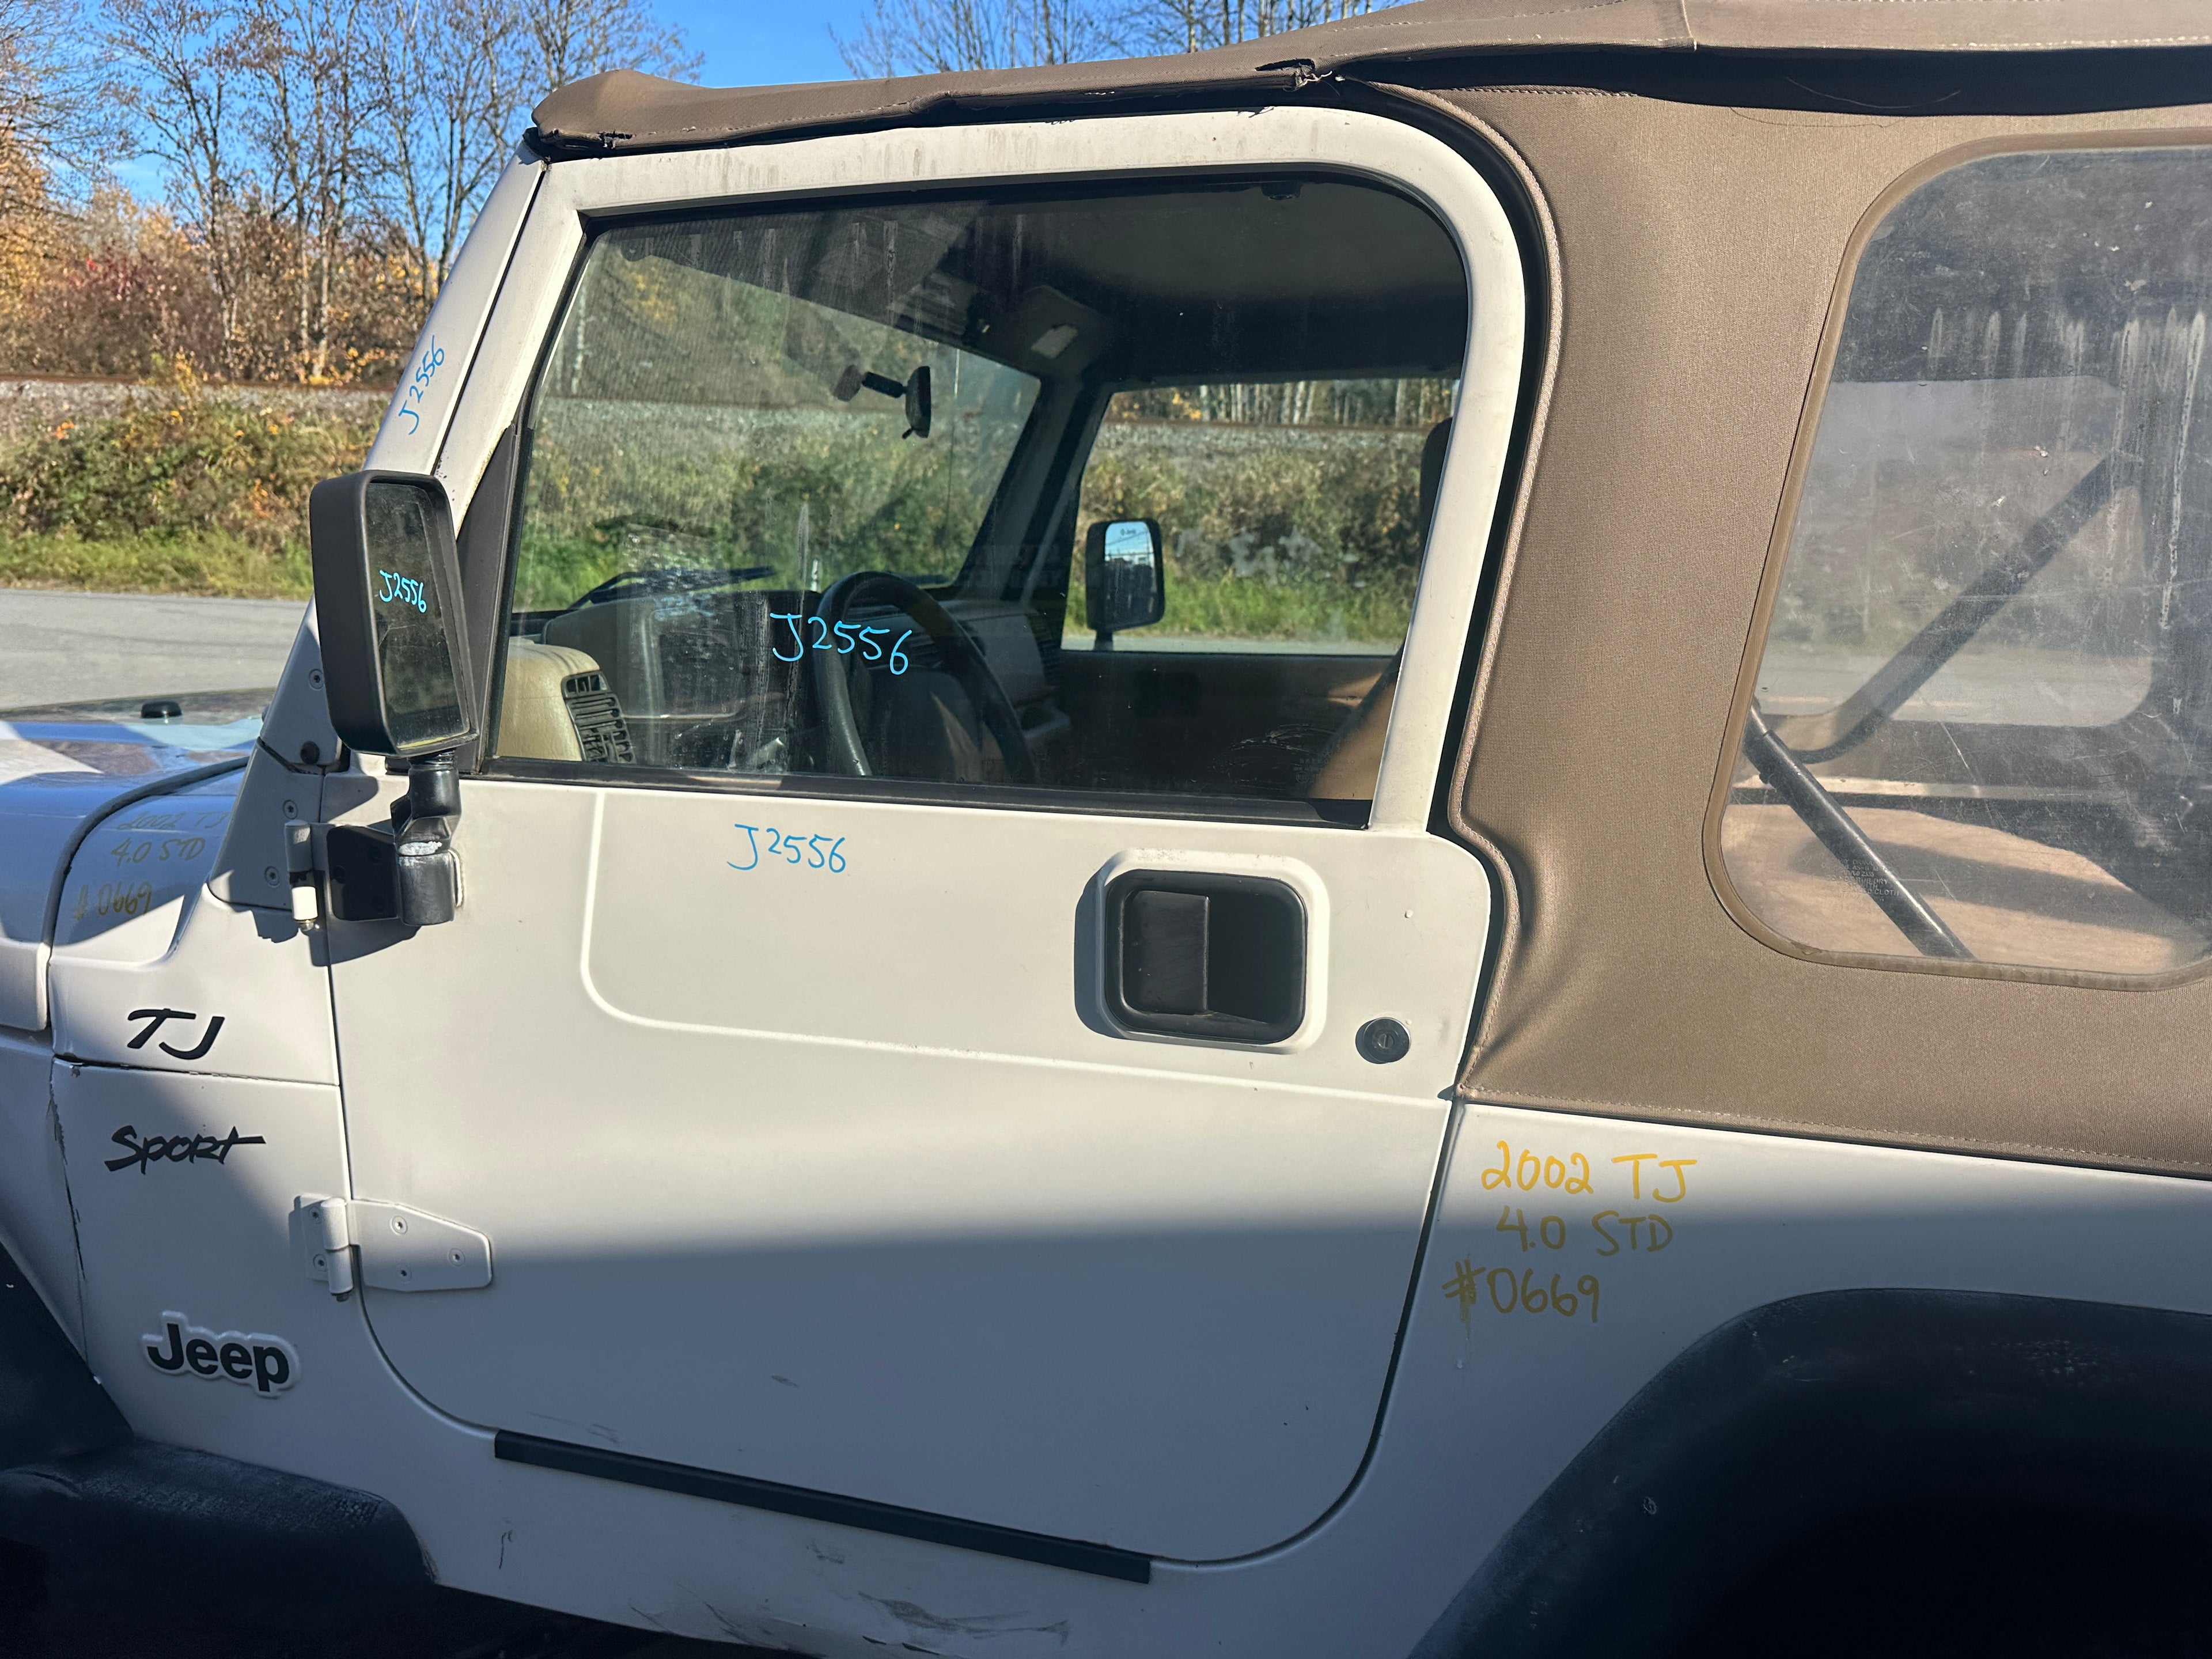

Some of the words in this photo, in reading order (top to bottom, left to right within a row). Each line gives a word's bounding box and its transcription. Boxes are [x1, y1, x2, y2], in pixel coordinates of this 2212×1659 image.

[398, 335, 445, 435] J2556
[378, 569, 427, 613] J2556
[770, 612, 912, 675] J2556
[110, 837, 153, 867] 4.0
[158, 837, 206, 861] STD
[726, 823, 847, 874] J2556
[127, 1008, 225, 1060] TJ
[1480, 1140, 1594, 1195] 2002
[1611, 1153, 1698, 1203] TJ
[1496, 1205, 1566, 1252] 4.0
[1590, 1210, 1673, 1257] STD
[1441, 1258, 1600, 1323] #0669
[146, 1323, 289, 1392] Jeep
